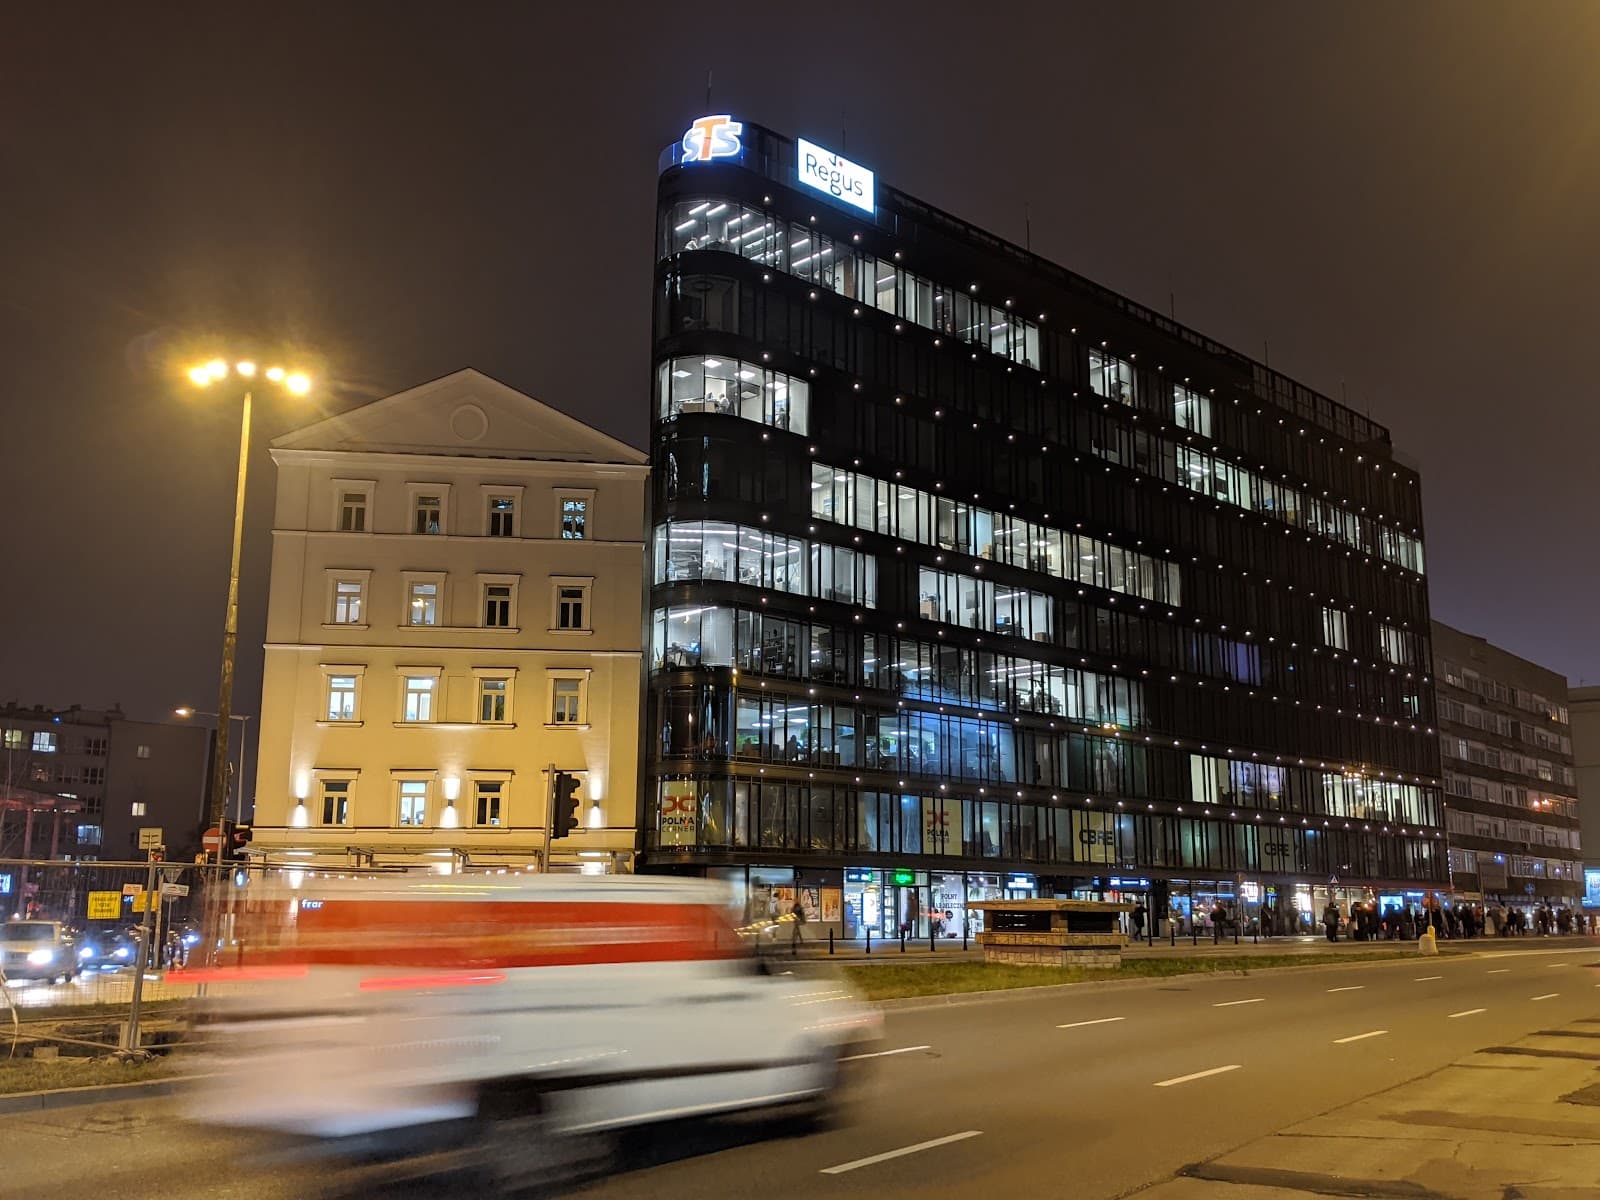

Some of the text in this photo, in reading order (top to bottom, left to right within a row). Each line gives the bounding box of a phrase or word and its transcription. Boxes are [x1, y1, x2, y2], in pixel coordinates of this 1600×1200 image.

[682, 115, 742, 161] STS
[806, 153, 863, 196] Regus
[662, 817, 695, 825] POLNA
[1079, 830, 1113, 846] CBRE
